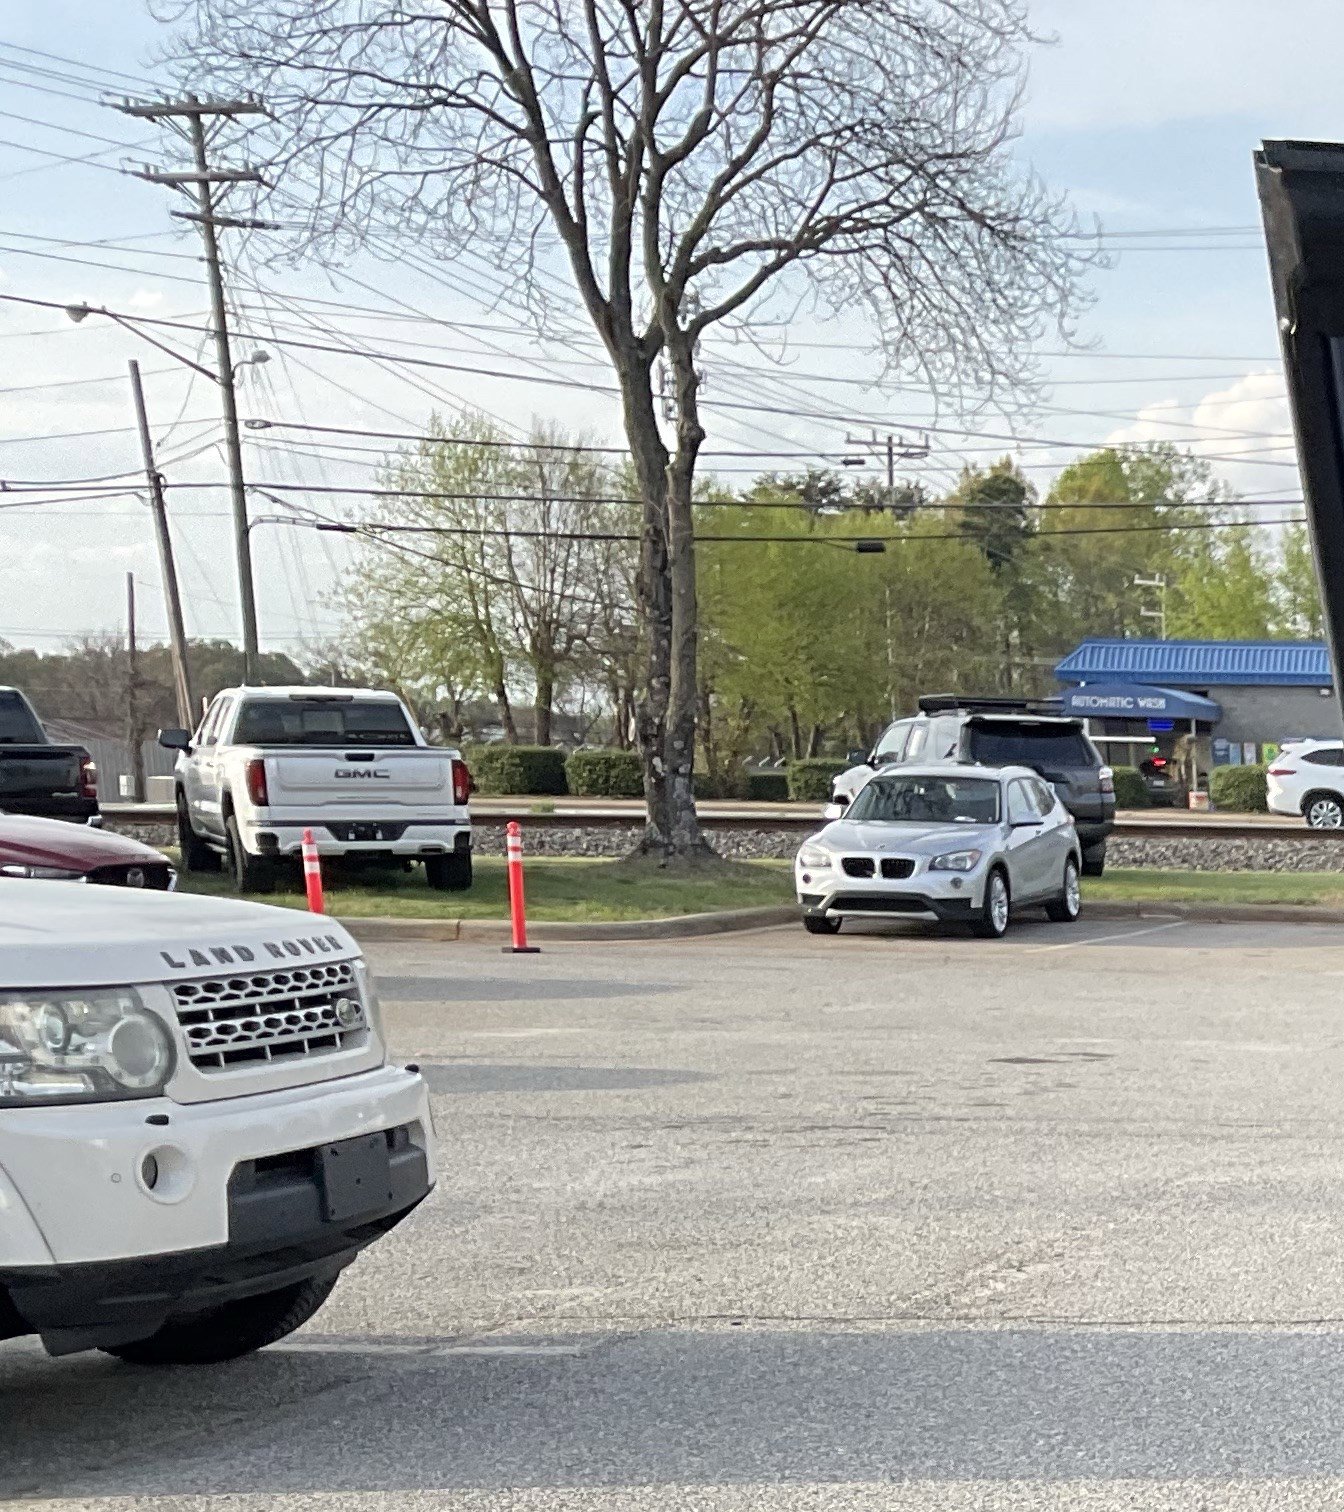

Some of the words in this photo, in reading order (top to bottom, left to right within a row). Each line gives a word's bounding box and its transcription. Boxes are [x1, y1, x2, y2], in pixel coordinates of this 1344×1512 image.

[1071, 694, 1134, 709] AUTOMATIC
[1137, 697, 1166, 709] WASH
[334, 768, 390, 779] GMC
[160, 944, 255, 969] LAND
[263, 934, 344, 959] ROVER
